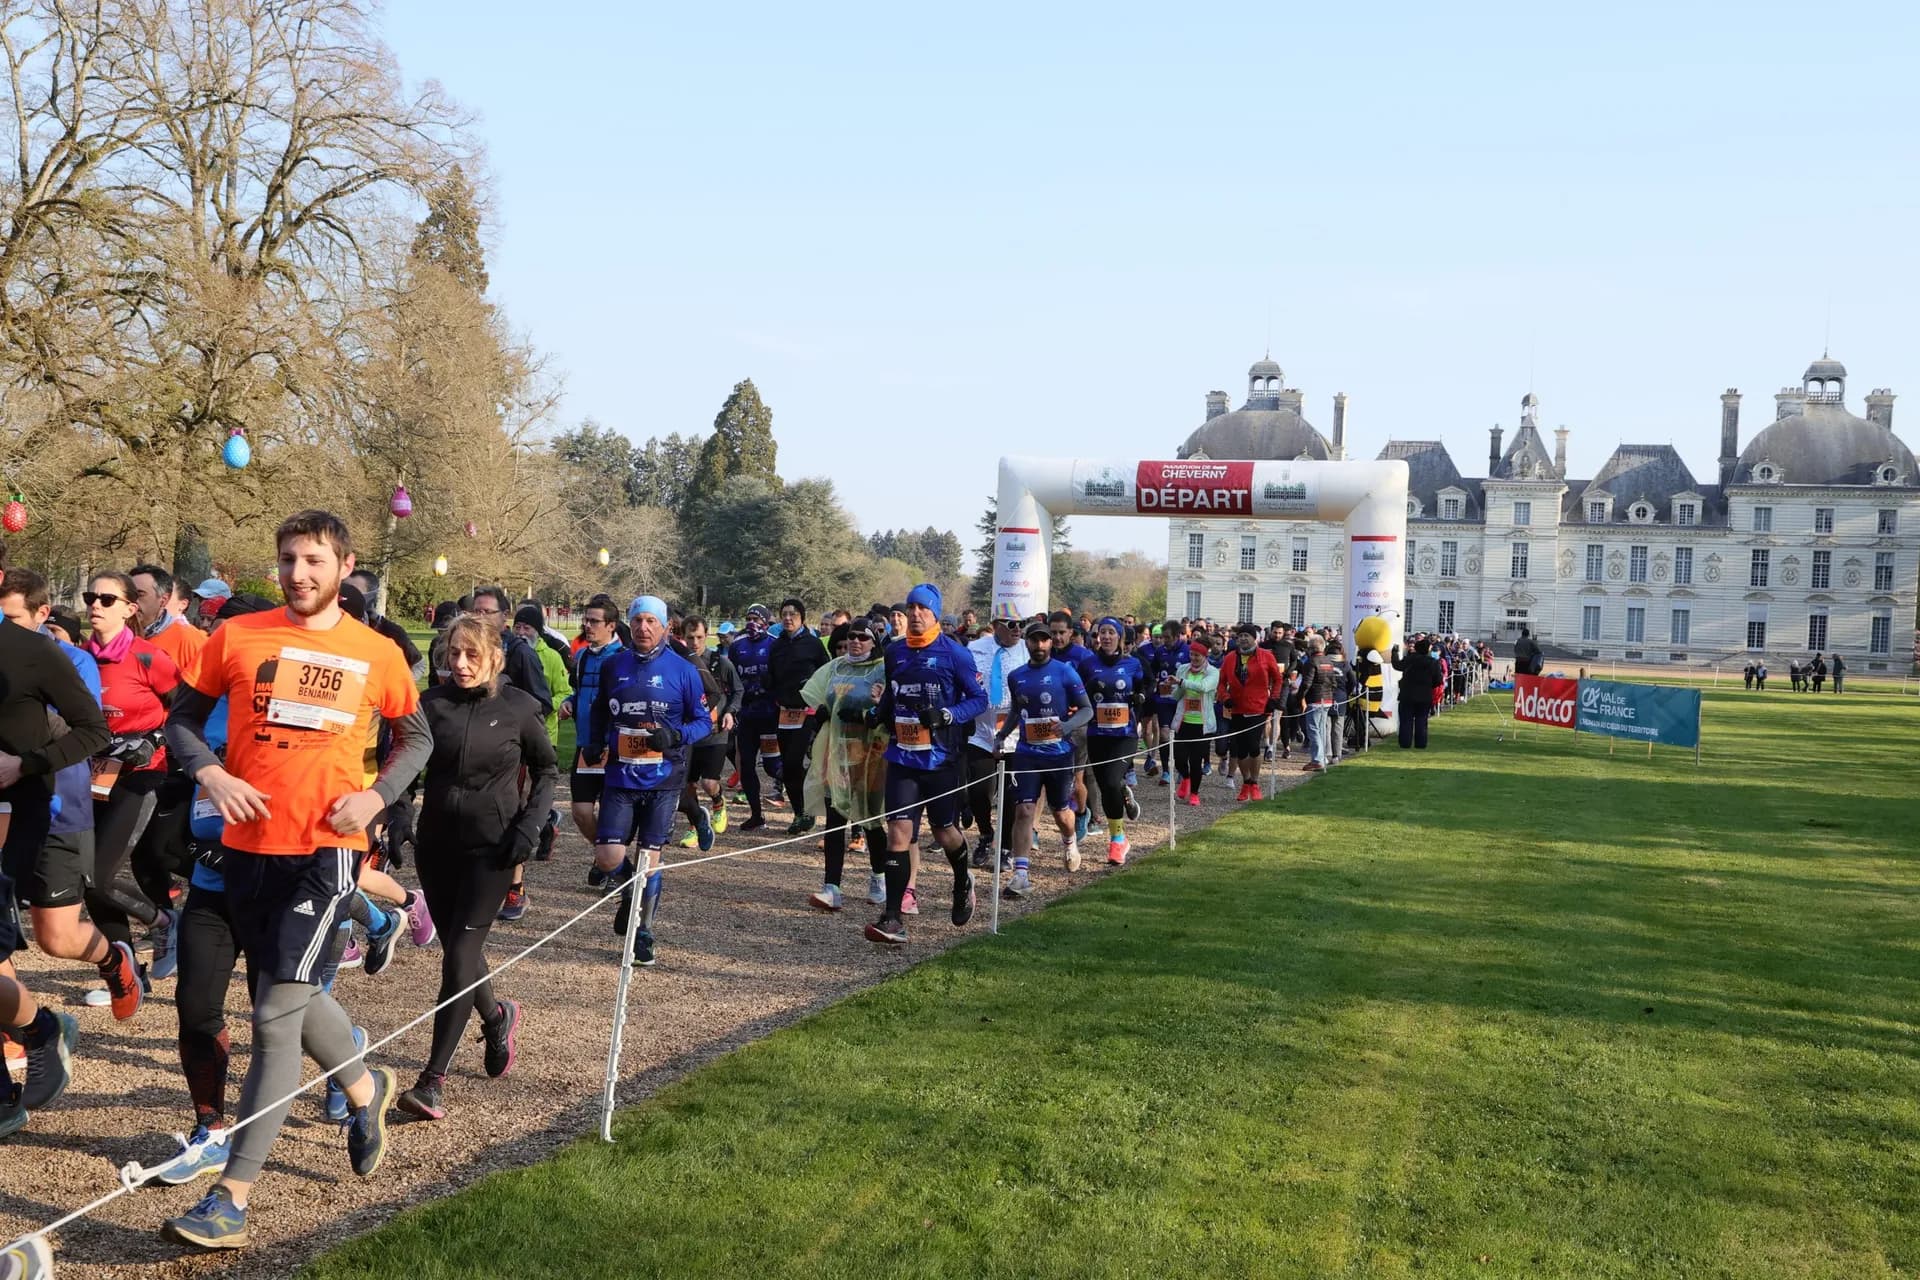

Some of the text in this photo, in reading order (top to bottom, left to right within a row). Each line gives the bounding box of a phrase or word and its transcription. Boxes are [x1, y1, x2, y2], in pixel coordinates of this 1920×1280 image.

[1162, 469, 1227, 479] CHEVERNY
[1141, 483, 1248, 509] DÉPART
[299, 665, 343, 691] 3756
[298, 686, 338, 702] BENJAMIN
[1600, 691, 1616, 704] VAL
[1515, 686, 1575, 723] Adecco
[1600, 704, 1635, 719] FRANCE
